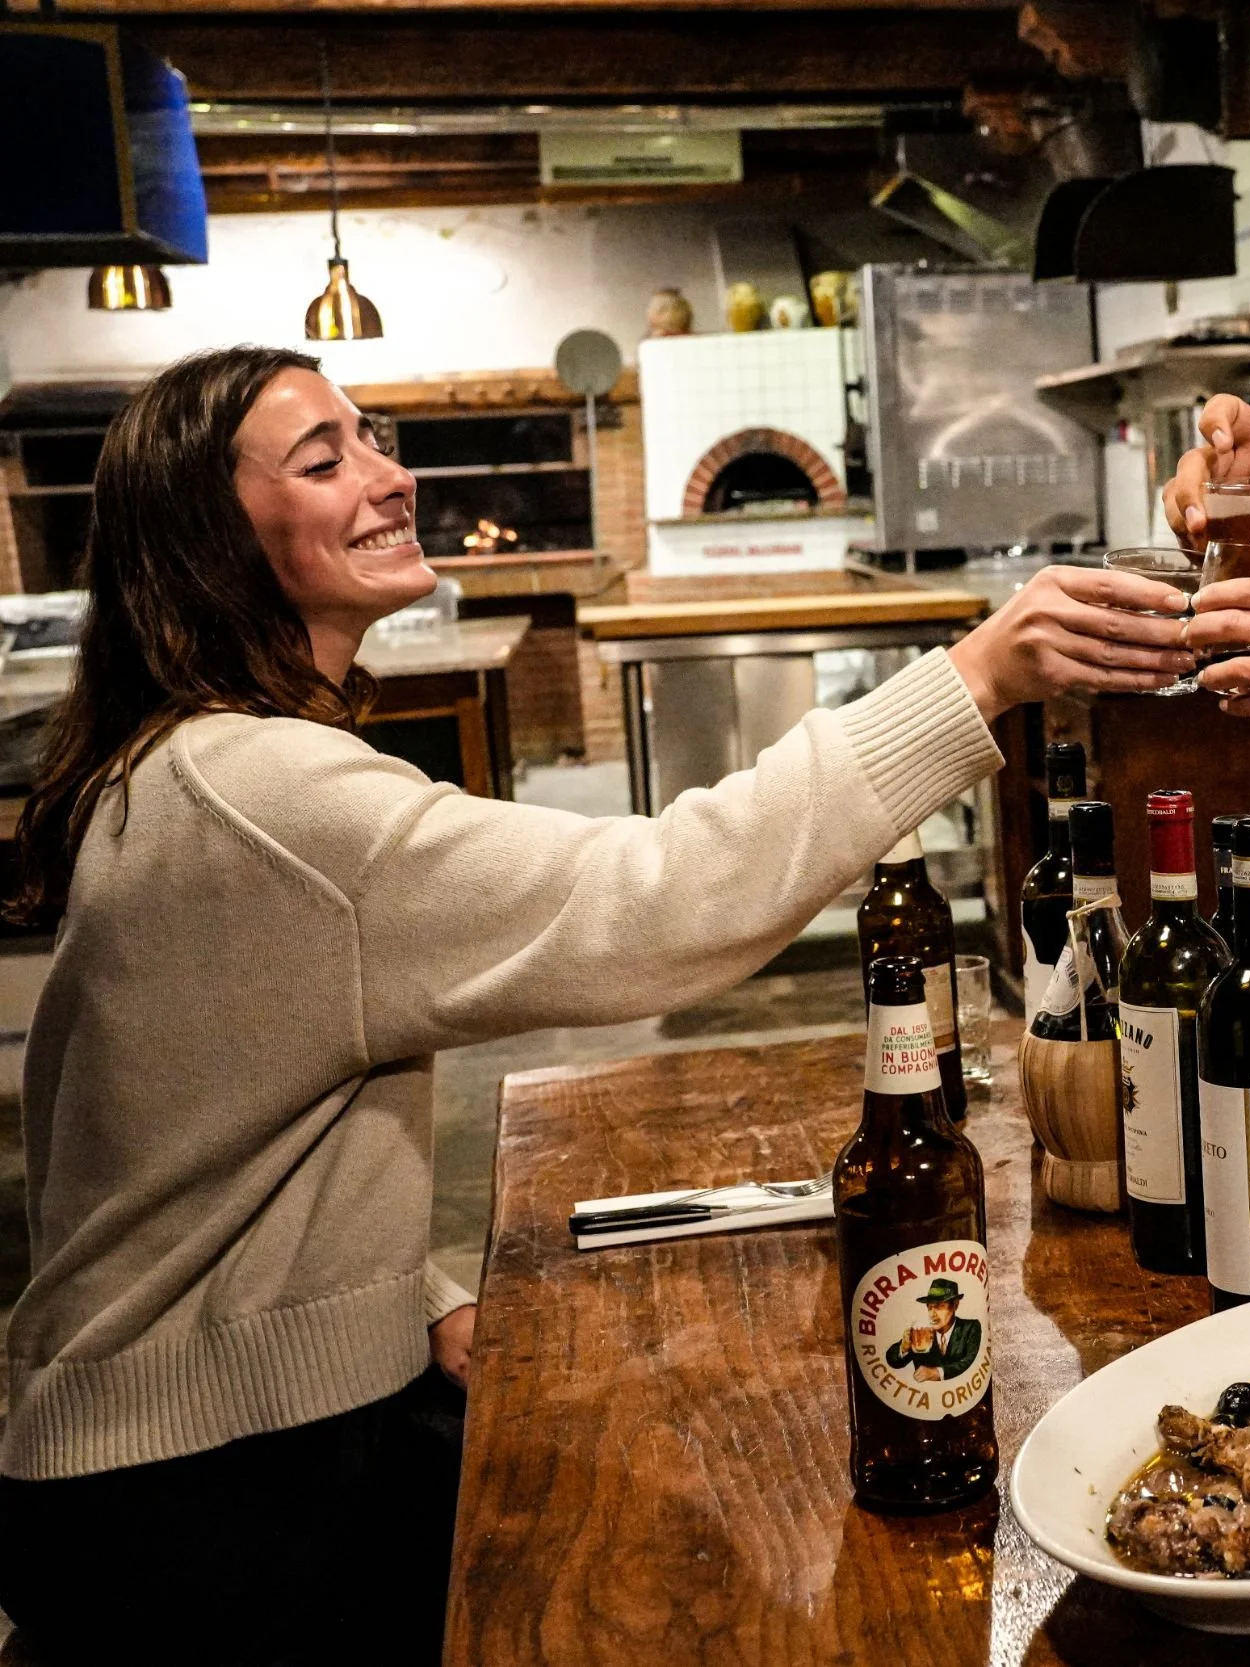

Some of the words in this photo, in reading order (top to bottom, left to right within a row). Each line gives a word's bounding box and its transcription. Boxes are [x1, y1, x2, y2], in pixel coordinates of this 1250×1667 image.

[890, 1026, 908, 1036] DAL
[912, 1023, 928, 1034] 1859
[881, 1052, 894, 1064] IN
[858, 1263, 918, 1337] BIRRA
[923, 1250, 991, 1307] MORE
[861, 1344, 930, 1410] RICETTA
[941, 1338, 993, 1409] ORIGIN
